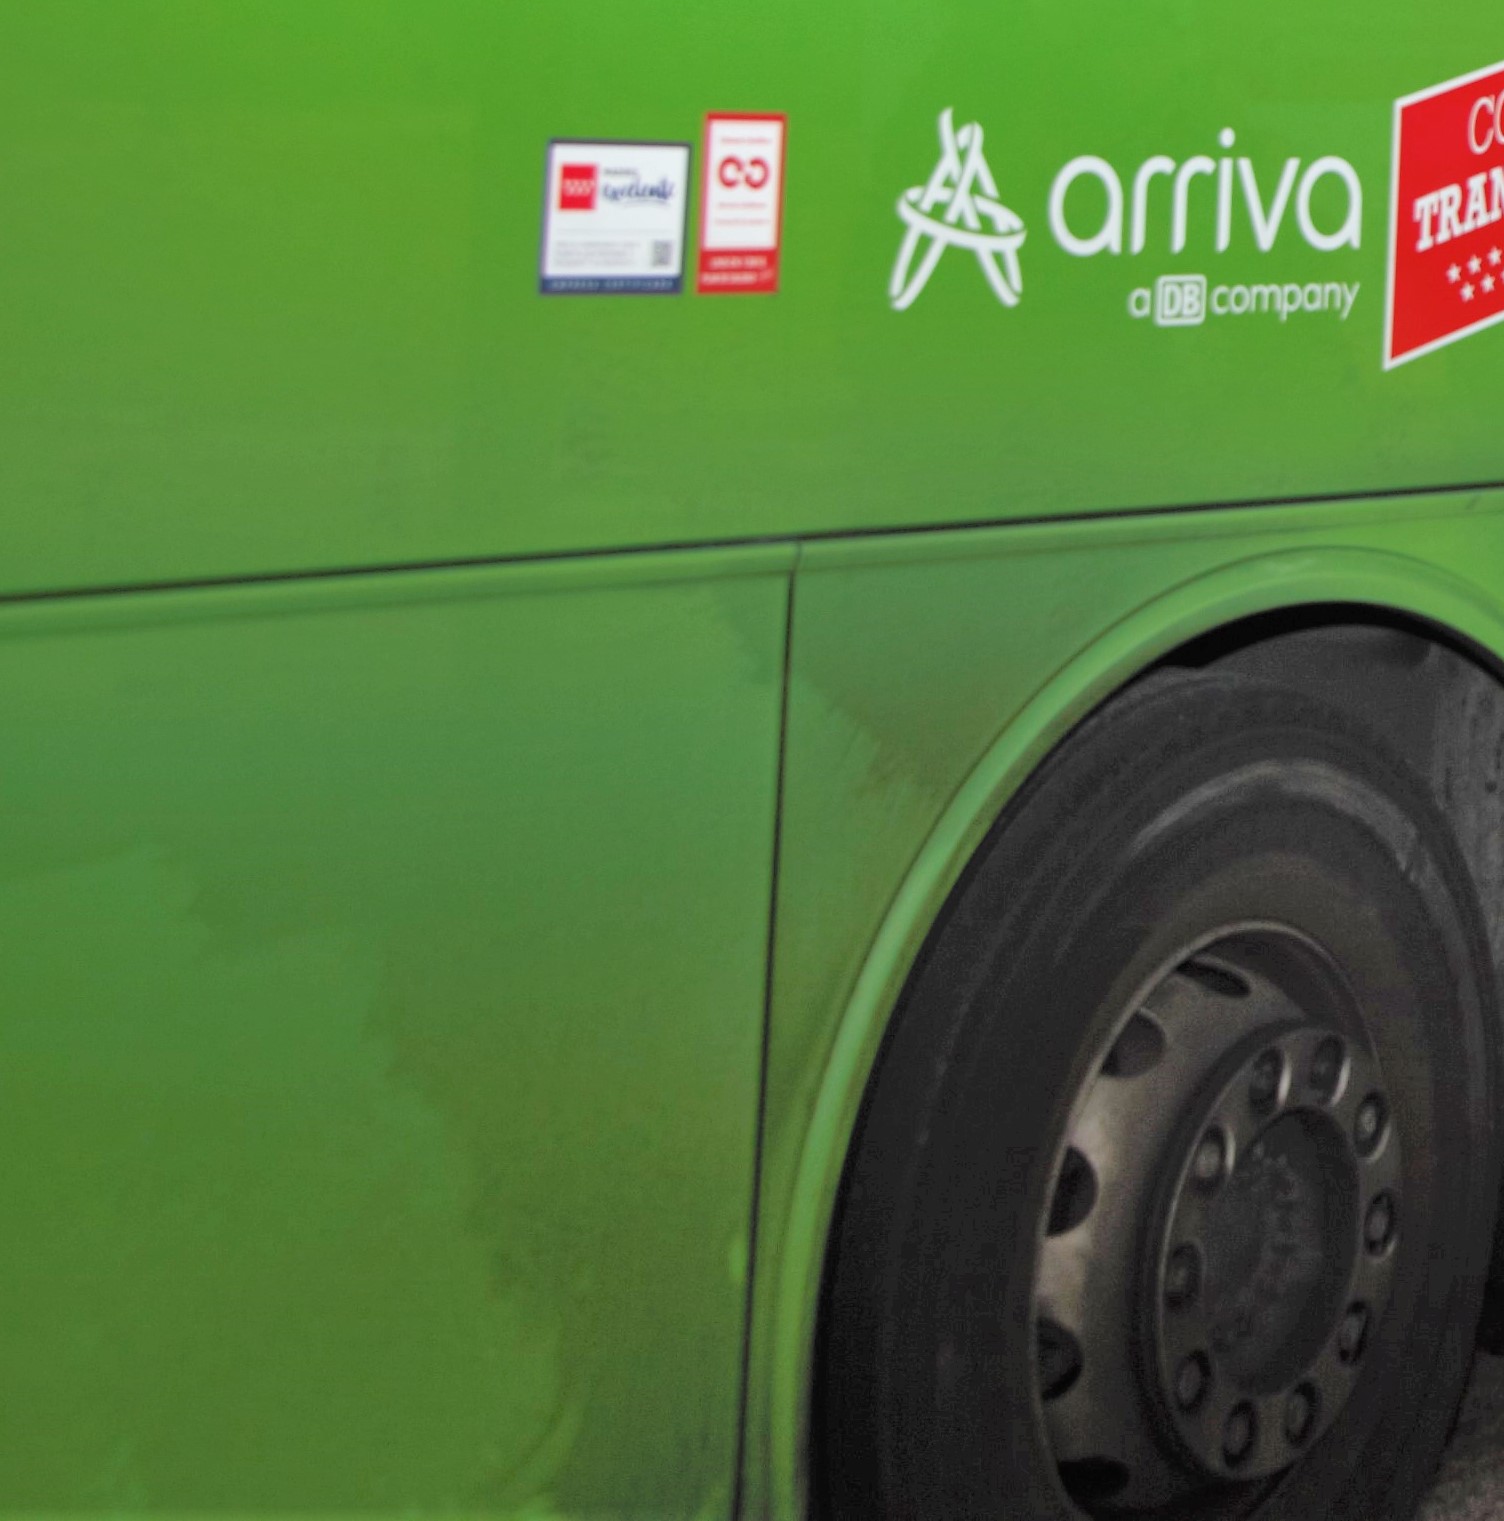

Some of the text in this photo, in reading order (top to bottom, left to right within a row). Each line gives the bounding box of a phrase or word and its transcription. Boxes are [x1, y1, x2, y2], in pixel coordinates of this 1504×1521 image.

[1048, 126, 1363, 256] arriva
[1127, 279, 1361, 323] a DB company
